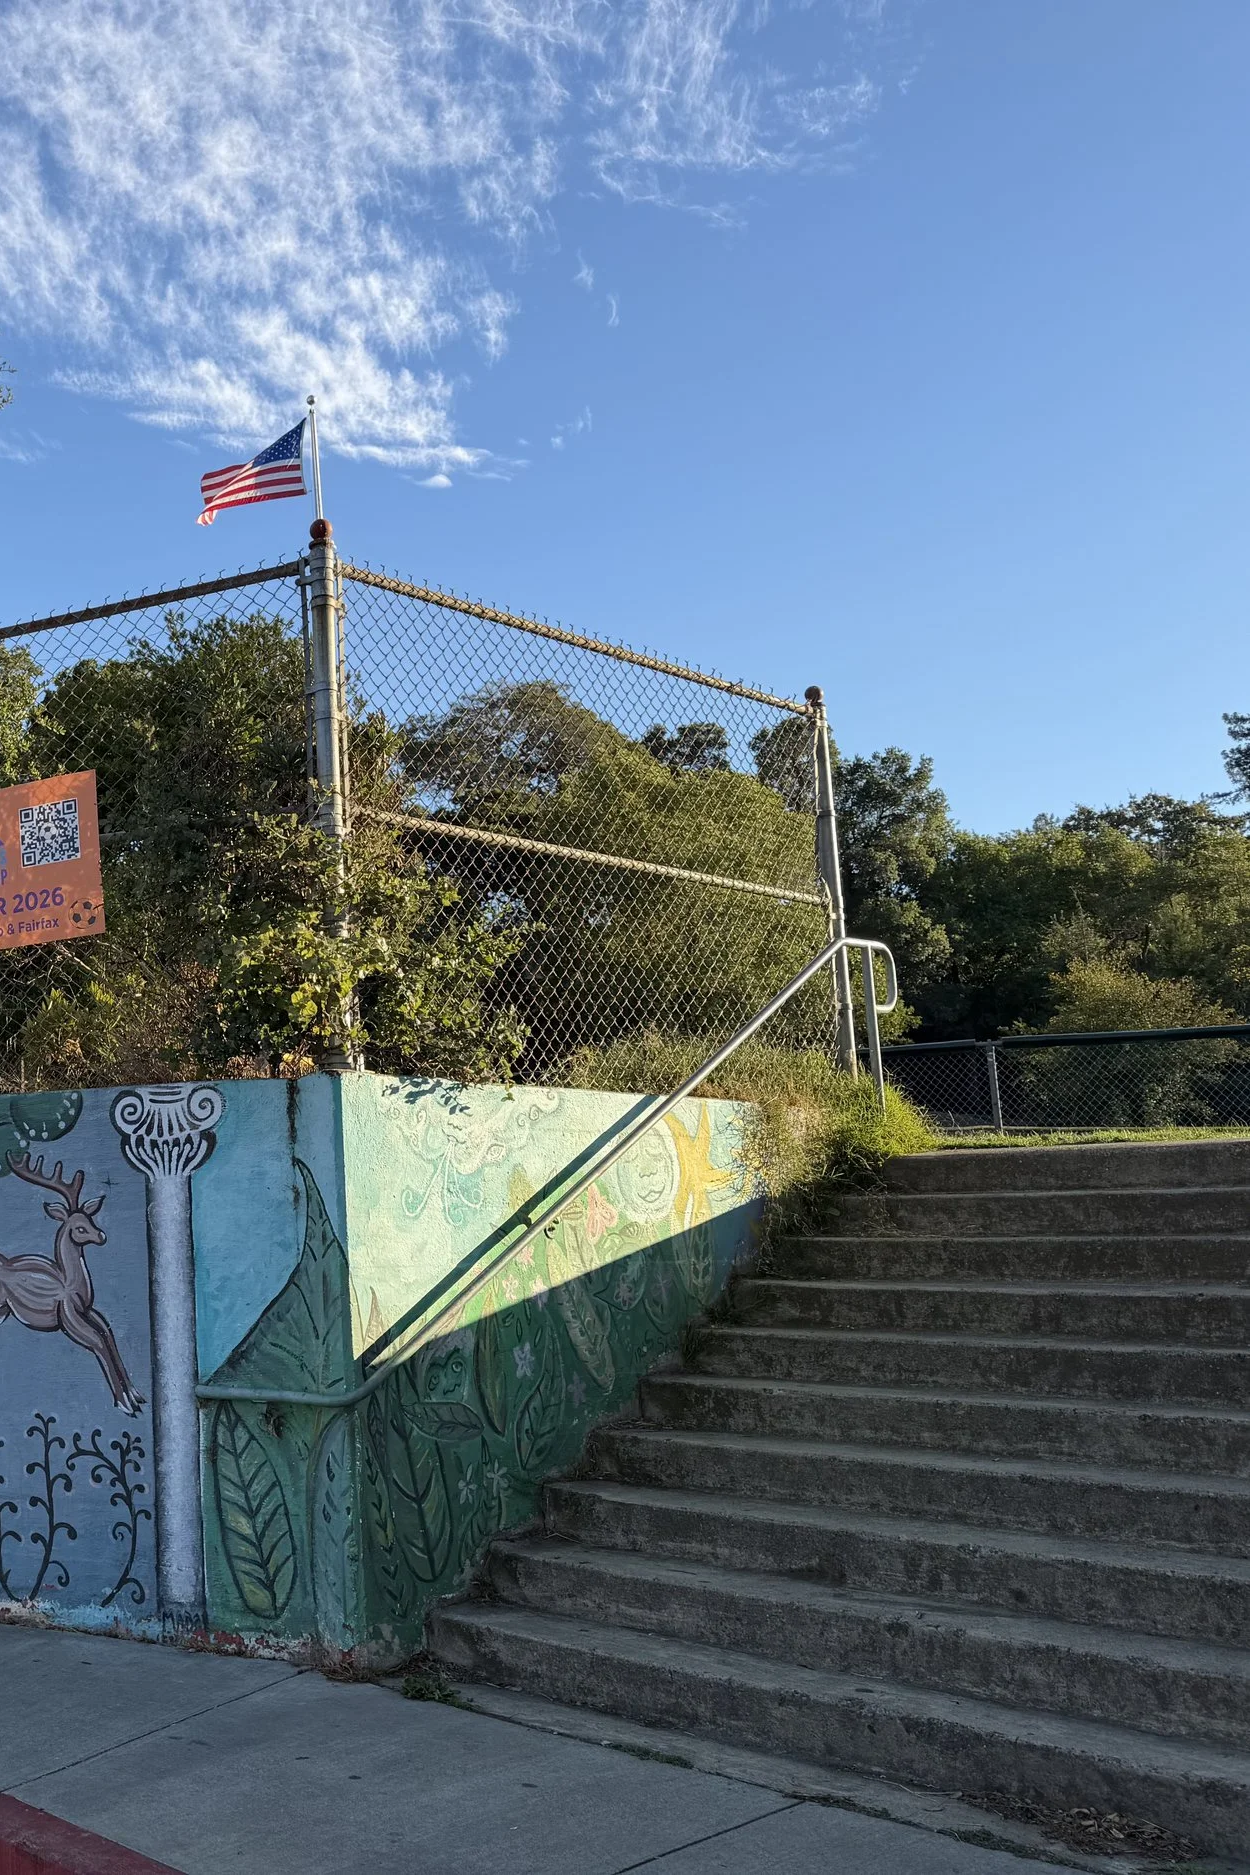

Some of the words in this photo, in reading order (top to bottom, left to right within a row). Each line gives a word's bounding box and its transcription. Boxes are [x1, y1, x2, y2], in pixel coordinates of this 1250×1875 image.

[13, 886, 65, 914] 2026
[7, 923, 15, 935] &
[18, 917, 60, 934] Fairfax
